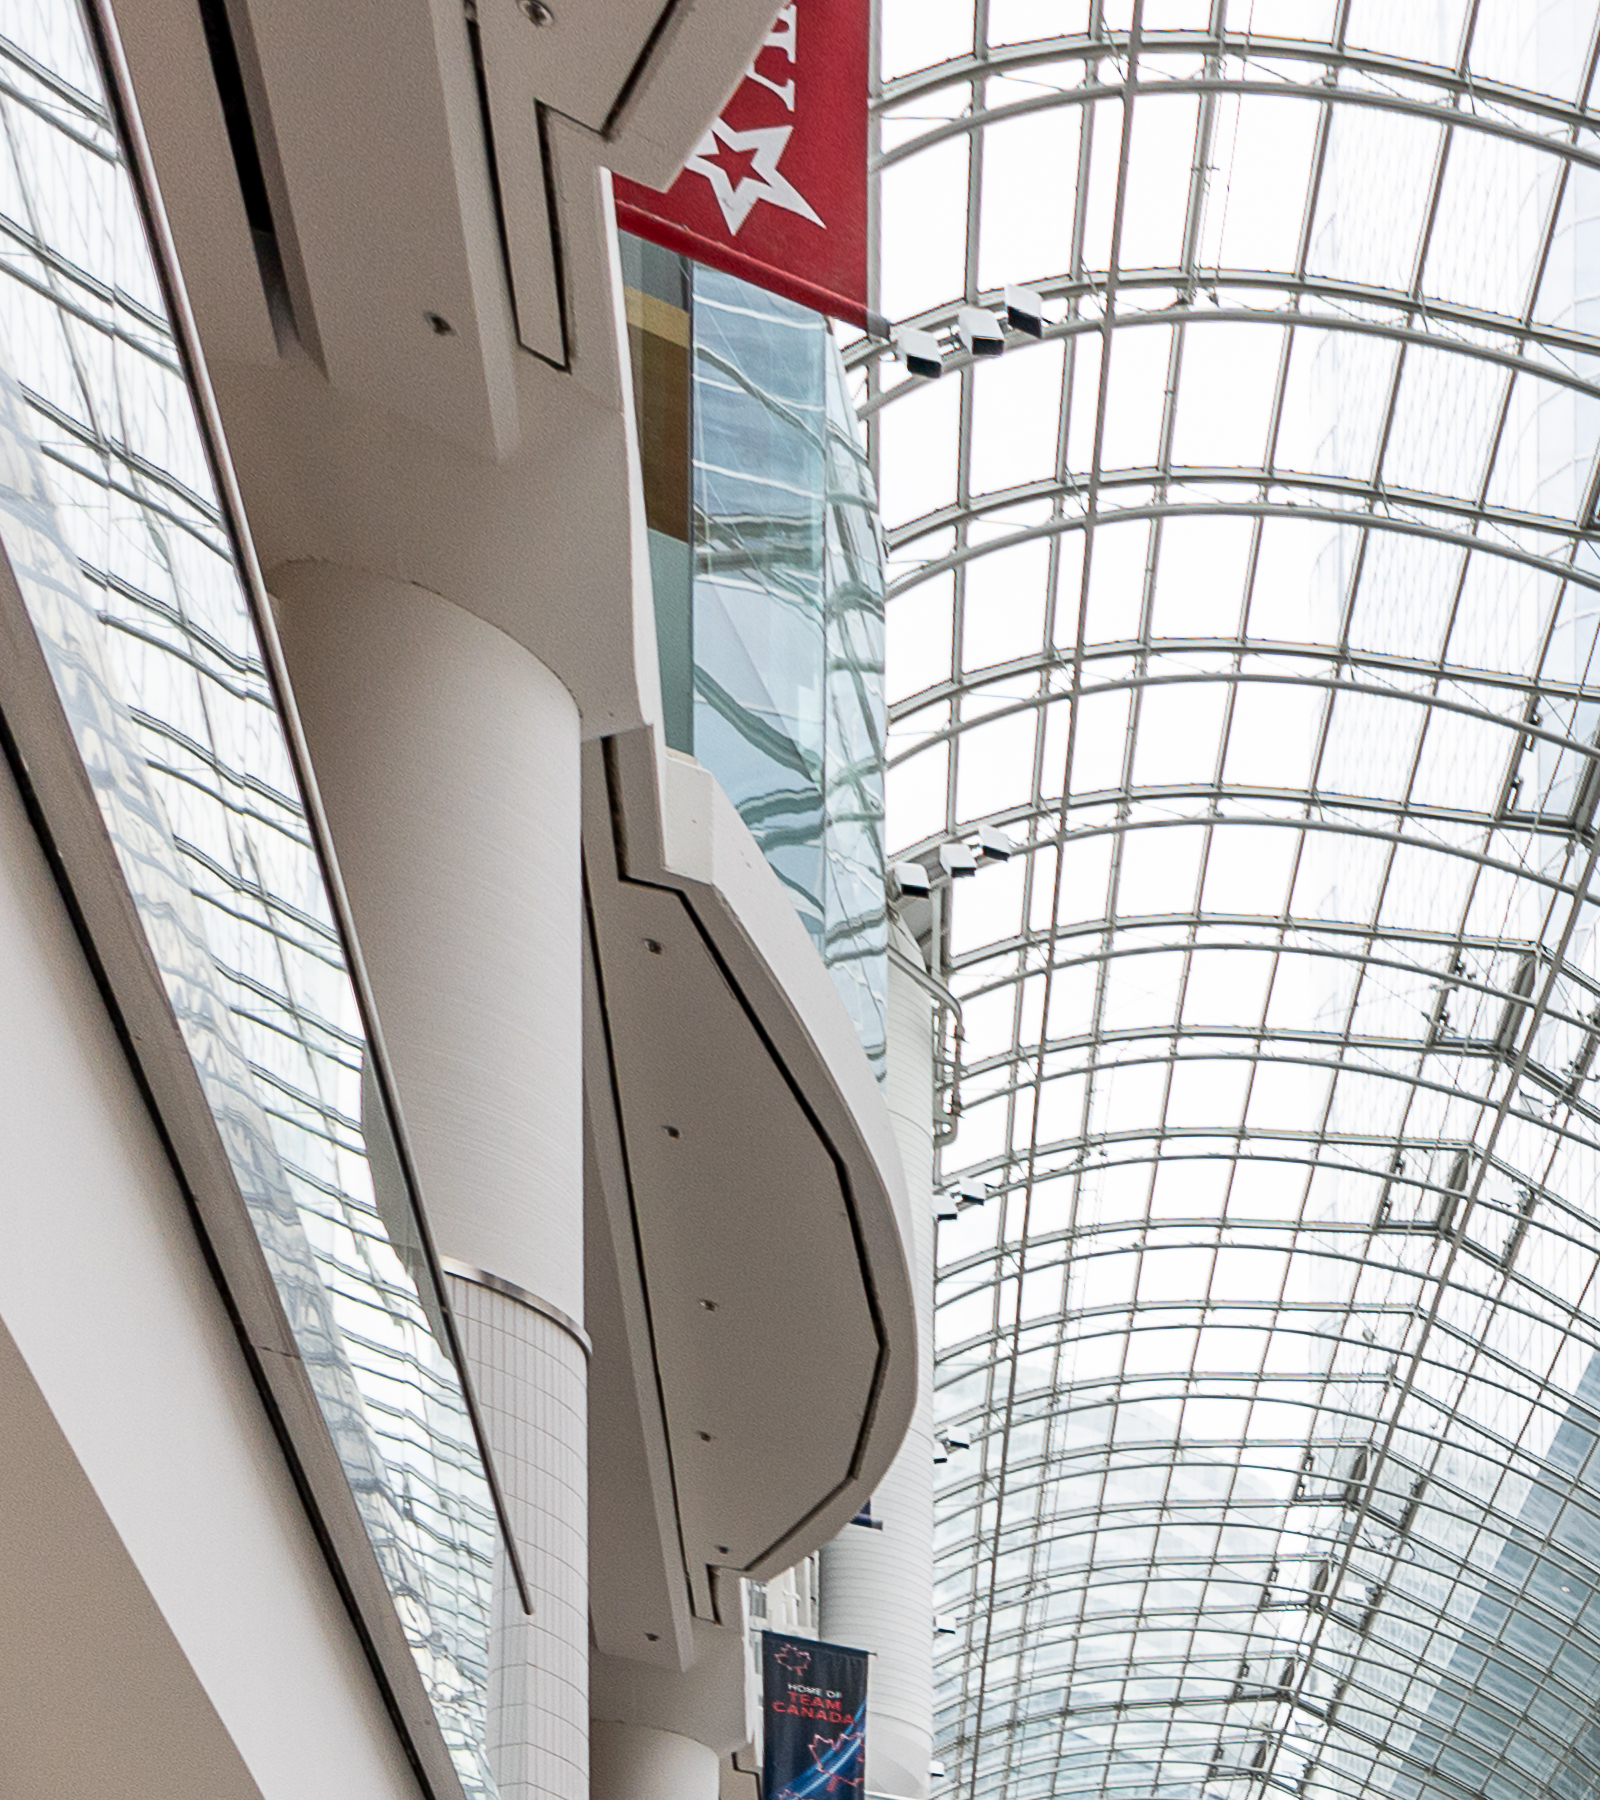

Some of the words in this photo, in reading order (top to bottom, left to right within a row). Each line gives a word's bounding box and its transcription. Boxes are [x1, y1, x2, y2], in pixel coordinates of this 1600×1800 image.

[788, 1683, 822, 1696] HOME
[826, 1689, 842, 1699] OF
[788, 1691, 842, 1712] TEAM
[772, 1702, 855, 1725] CANADA
